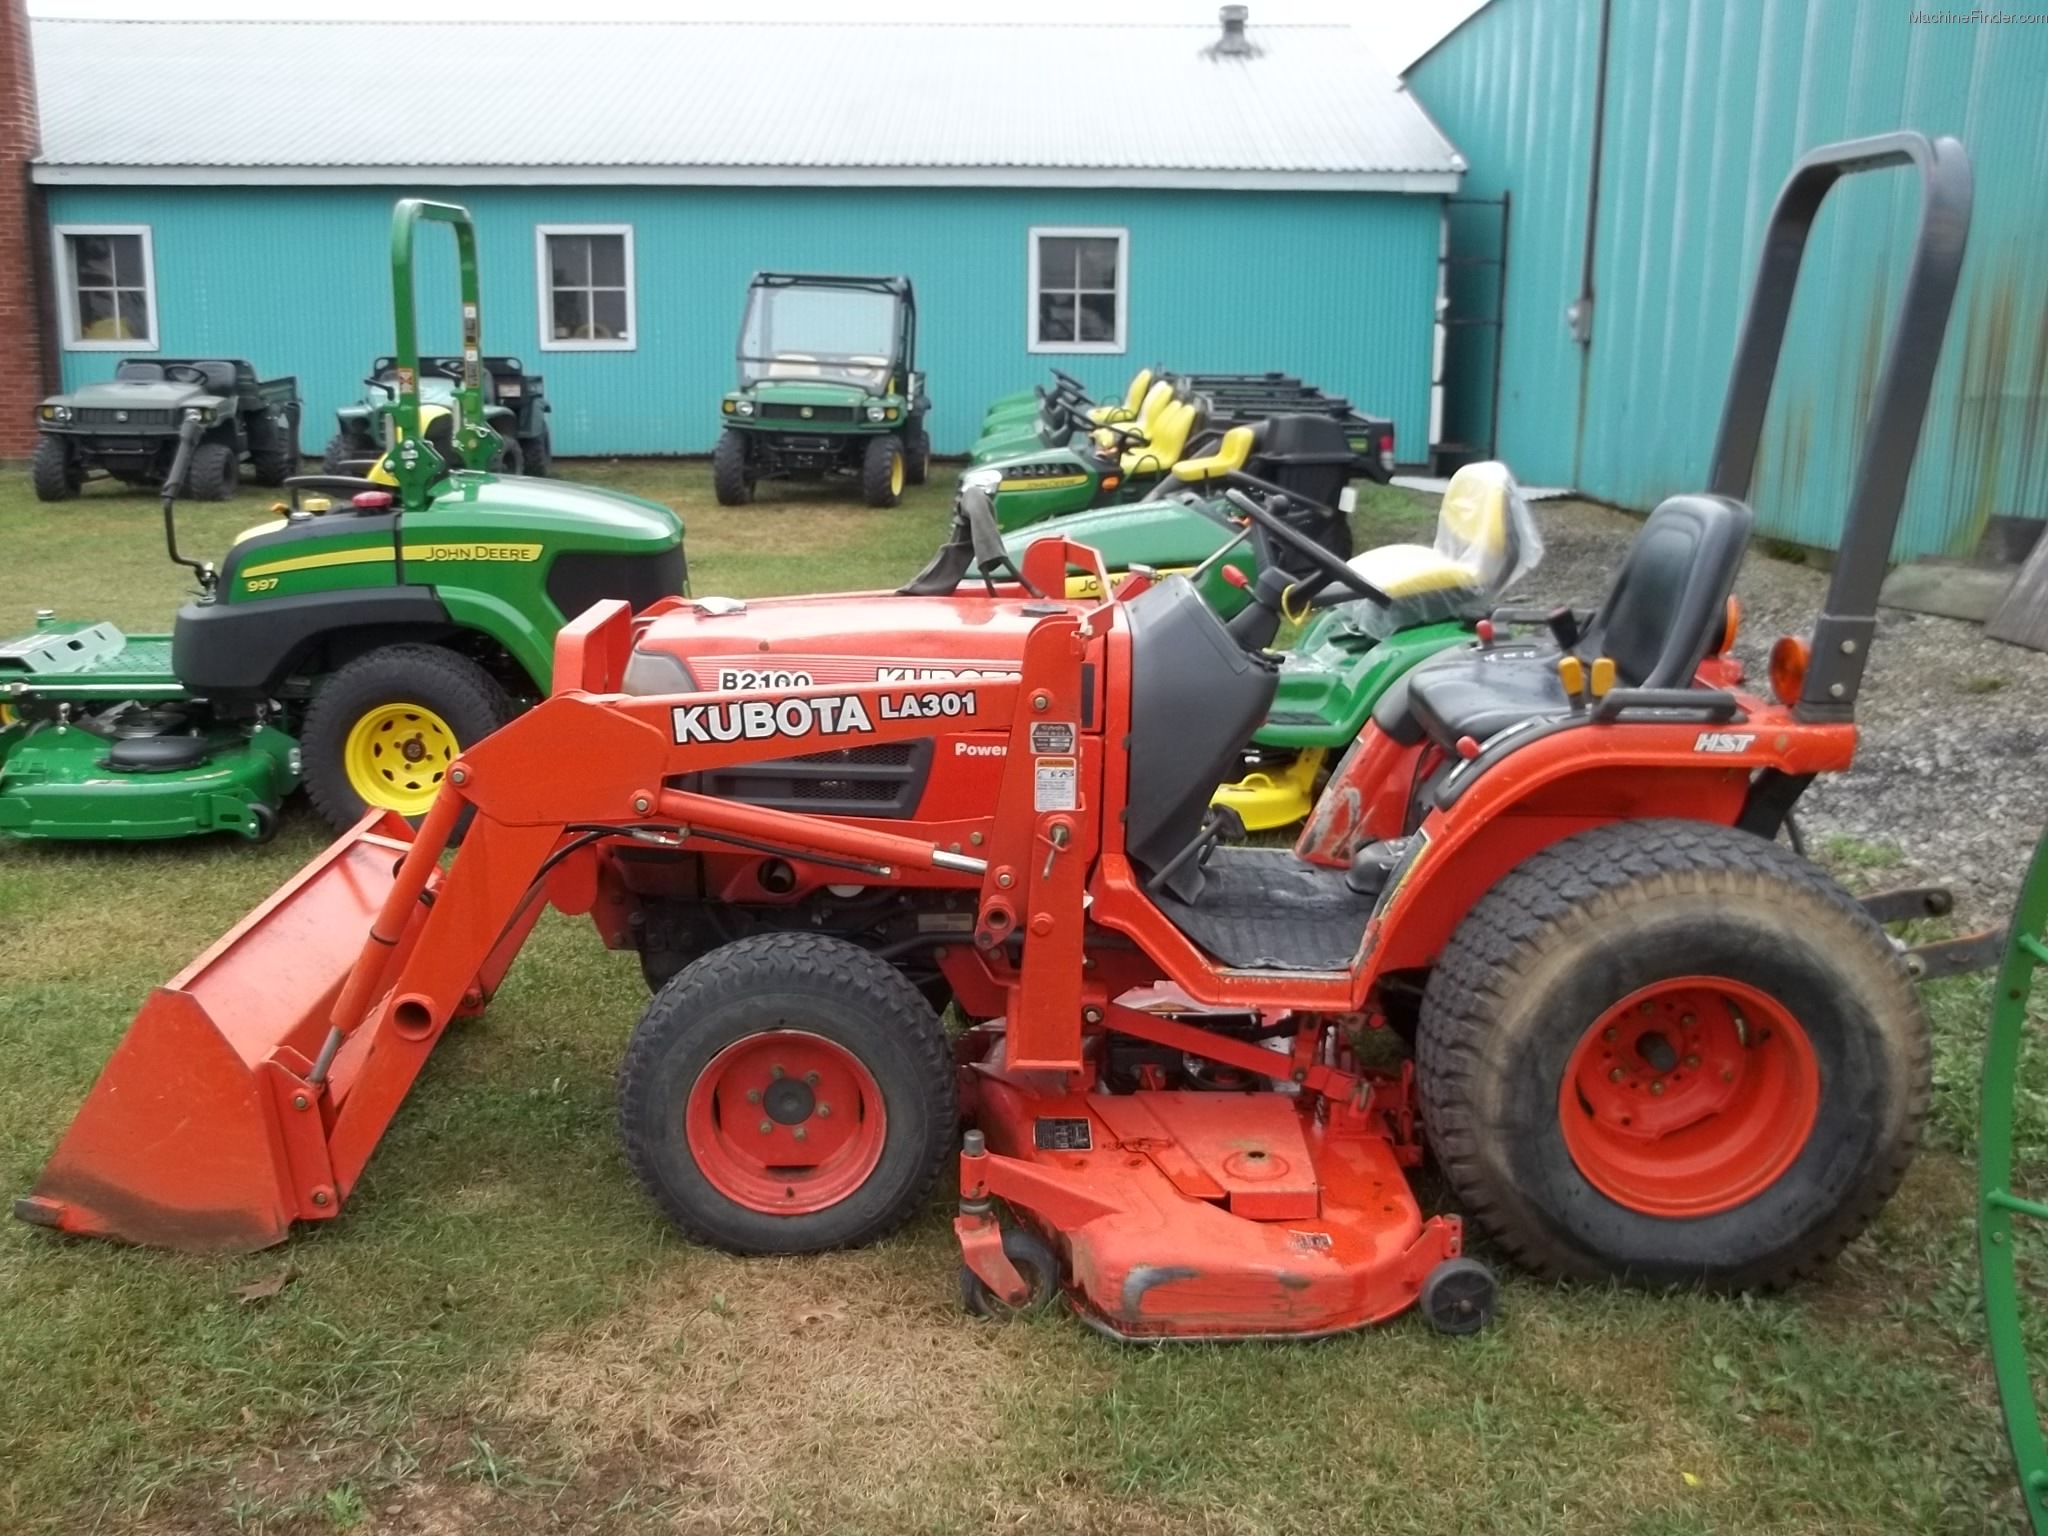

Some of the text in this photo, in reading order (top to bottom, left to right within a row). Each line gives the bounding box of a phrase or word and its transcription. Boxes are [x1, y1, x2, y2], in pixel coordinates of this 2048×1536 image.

[425, 545, 532, 560] JOHN DEERE
[247, 577, 279, 592] 997
[722, 672, 810, 690] B2100
[671, 690, 975, 744] KUBOTA LA301
[1694, 733, 1756, 752] HST
